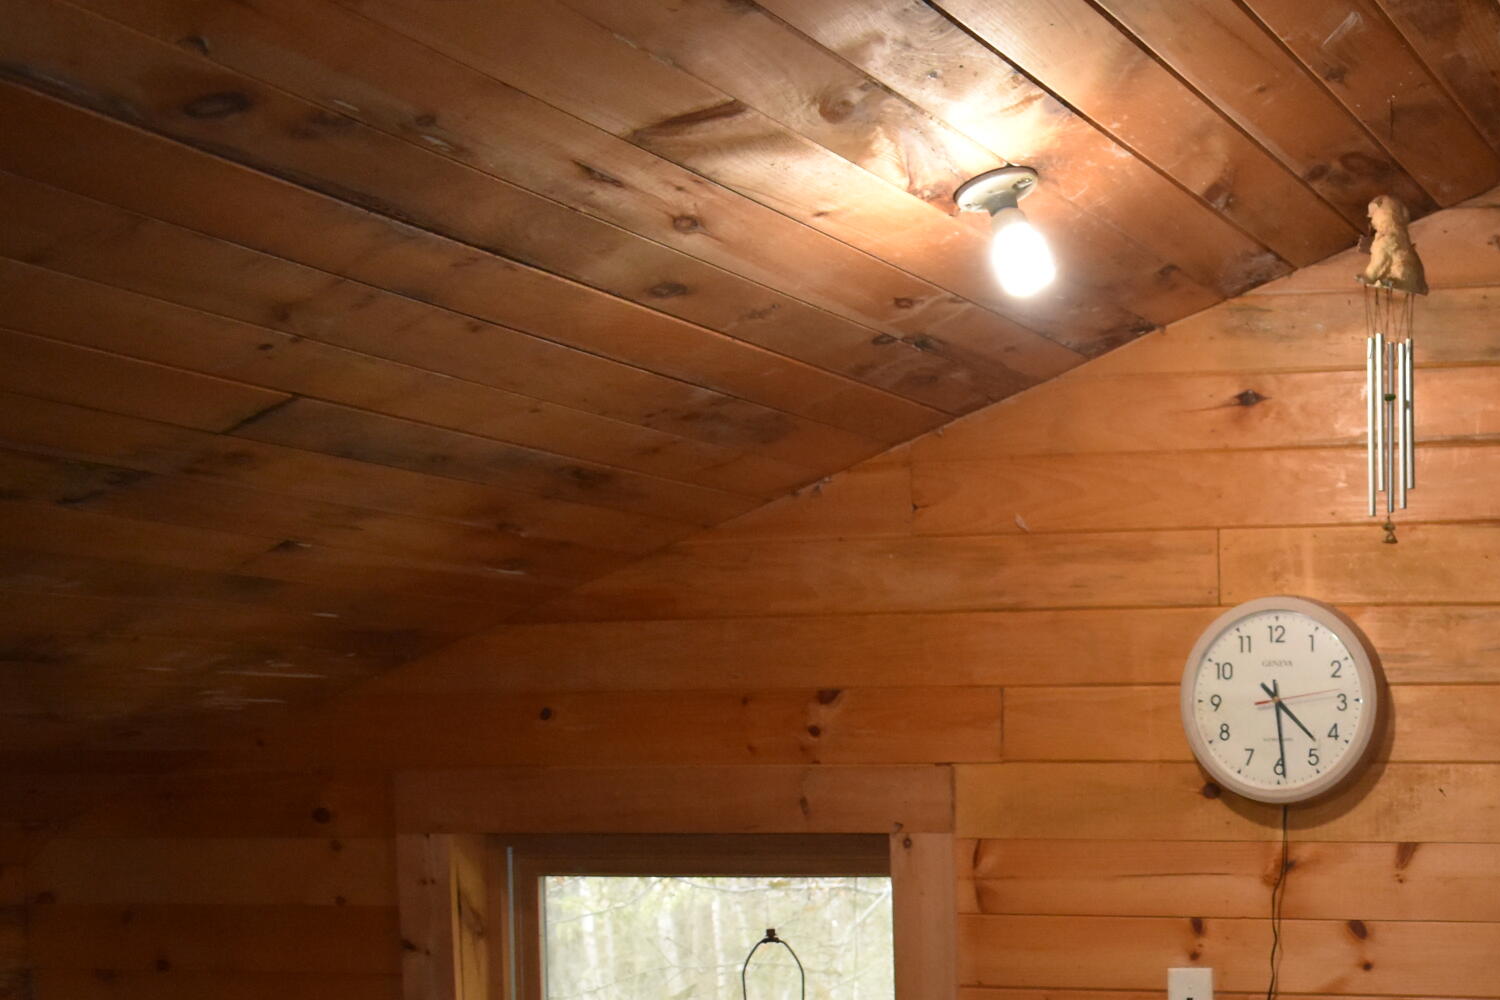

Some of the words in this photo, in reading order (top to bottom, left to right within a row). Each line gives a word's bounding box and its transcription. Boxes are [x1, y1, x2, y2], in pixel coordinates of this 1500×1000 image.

[1268, 625, 1285, 643] 12
[1239, 636, 1251, 652] 11
[1308, 635, 1314, 652] 1
[1215, 662, 1233, 680] 10
[1330, 660, 1342, 678] 2
[1210, 694, 1222, 711] 9
[1336, 693, 1348, 711] 3
[1219, 723, 1231, 740] 8
[1327, 723, 1340, 740] 4
[1245, 749, 1254, 766] 7
[1308, 749, 1319, 766] 5
[1273, 758, 1285, 775] 6
